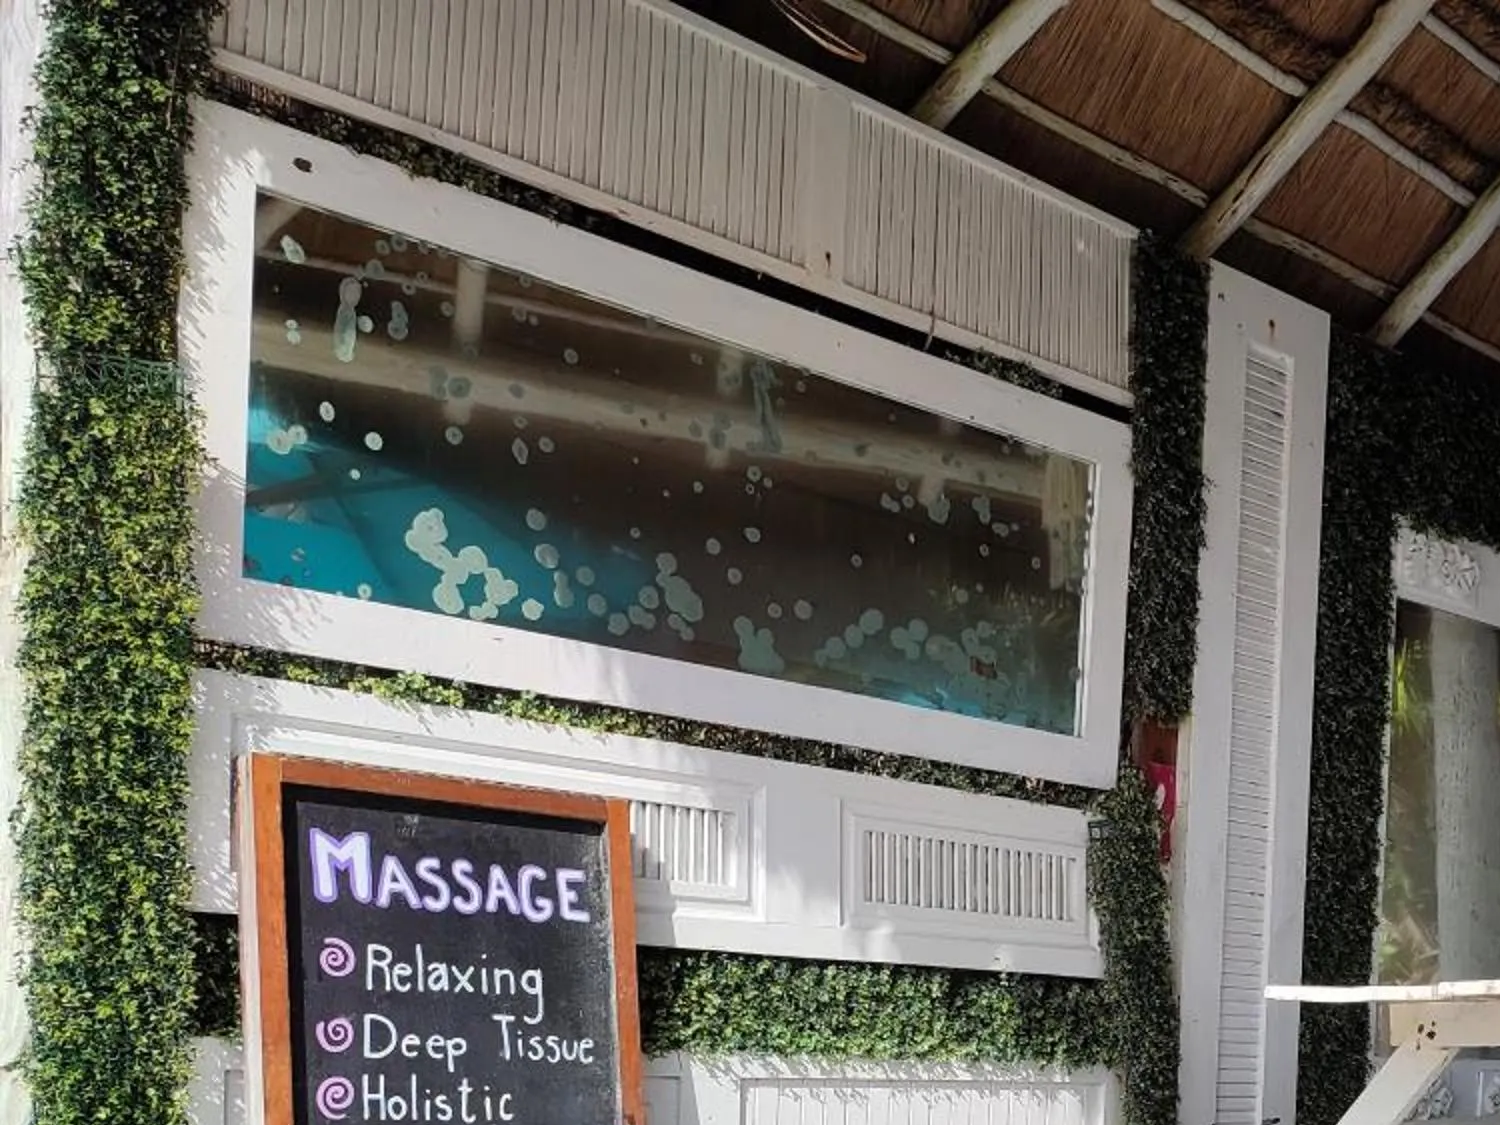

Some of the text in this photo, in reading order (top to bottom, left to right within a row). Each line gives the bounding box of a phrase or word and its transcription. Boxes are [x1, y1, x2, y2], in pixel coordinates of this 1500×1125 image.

[309, 826, 591, 924] MASSAGE
[365, 943, 544, 1025] Relaxing
[363, 1013, 595, 1073] Deep Tissue
[362, 1073, 516, 1123] Holistic
